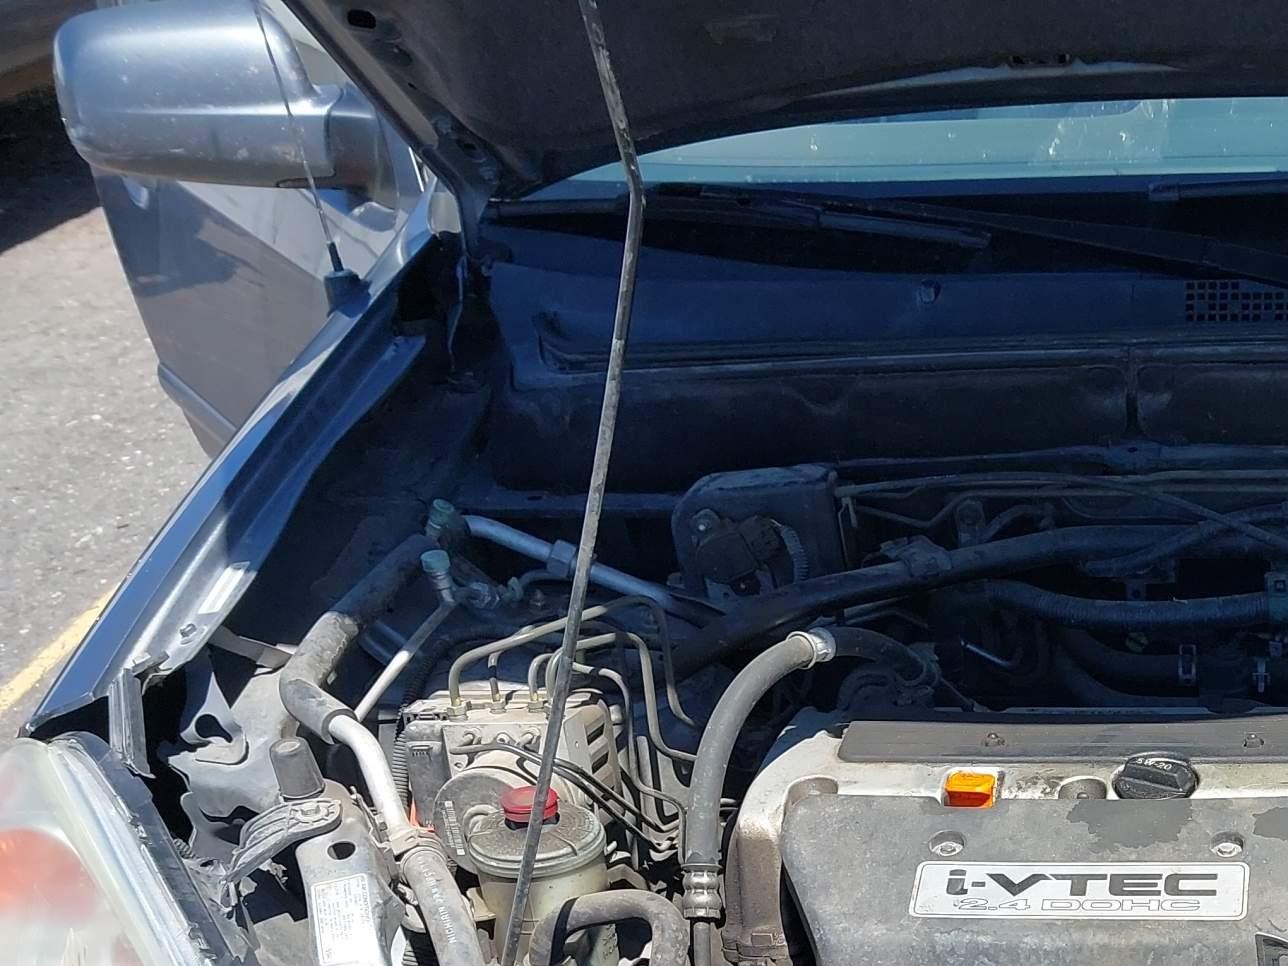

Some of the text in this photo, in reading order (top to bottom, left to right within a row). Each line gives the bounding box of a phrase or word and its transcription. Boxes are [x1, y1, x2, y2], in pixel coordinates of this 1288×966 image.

[946, 868, 1218, 897] i-VTEC
[957, 898, 1201, 912] 2.4 DOHC
